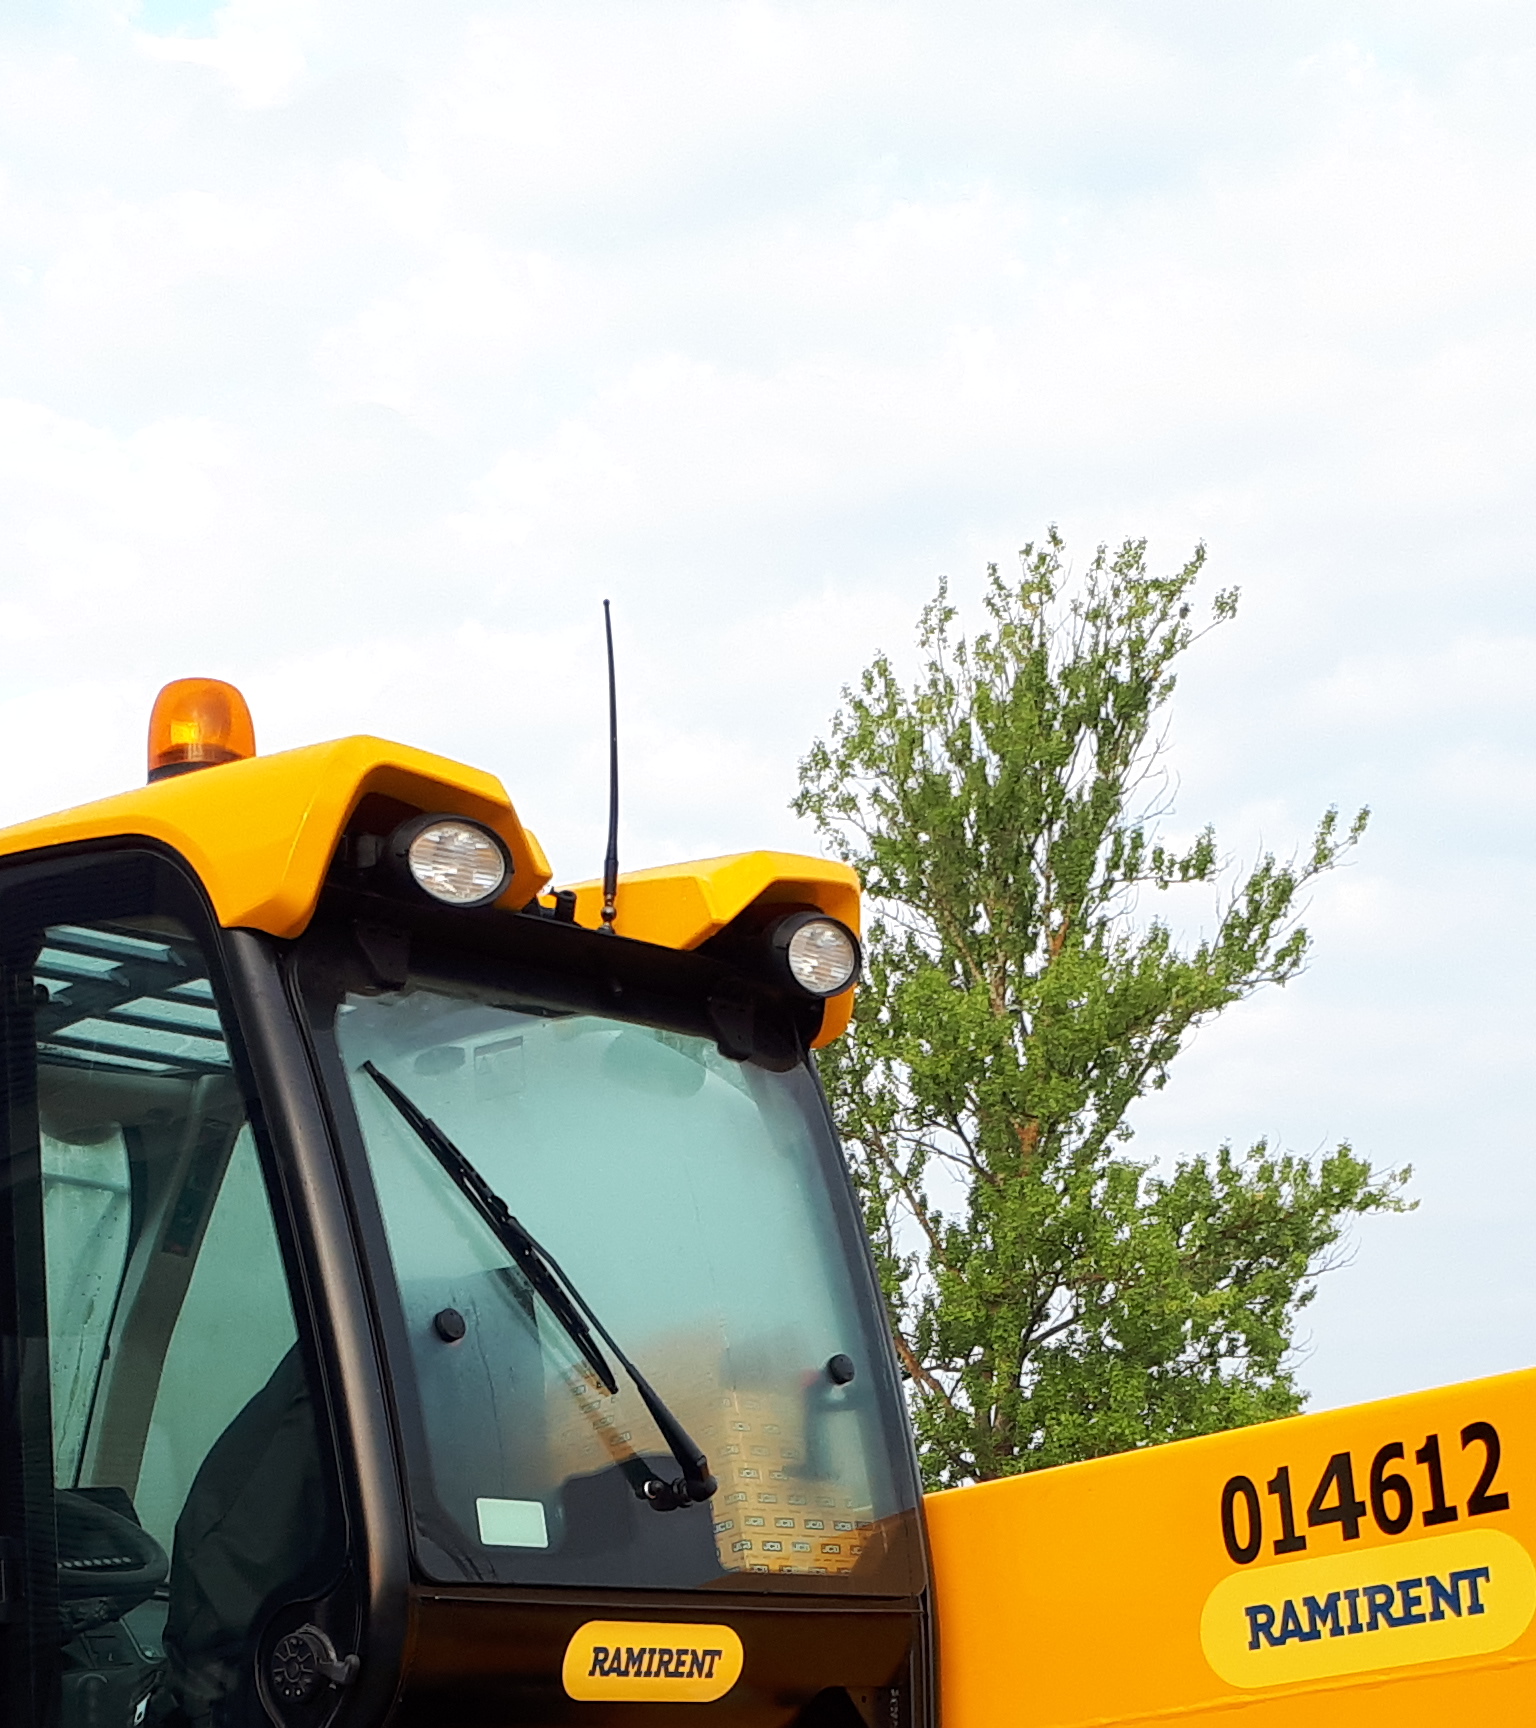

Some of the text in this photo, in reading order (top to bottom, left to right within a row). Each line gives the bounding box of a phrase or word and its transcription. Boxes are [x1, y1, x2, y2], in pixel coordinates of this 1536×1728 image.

[1221, 1422, 1510, 1565] 014612
[1245, 1566, 1490, 1651] RAMIRENT
[588, 1647, 722, 1679] RAMIRENT
